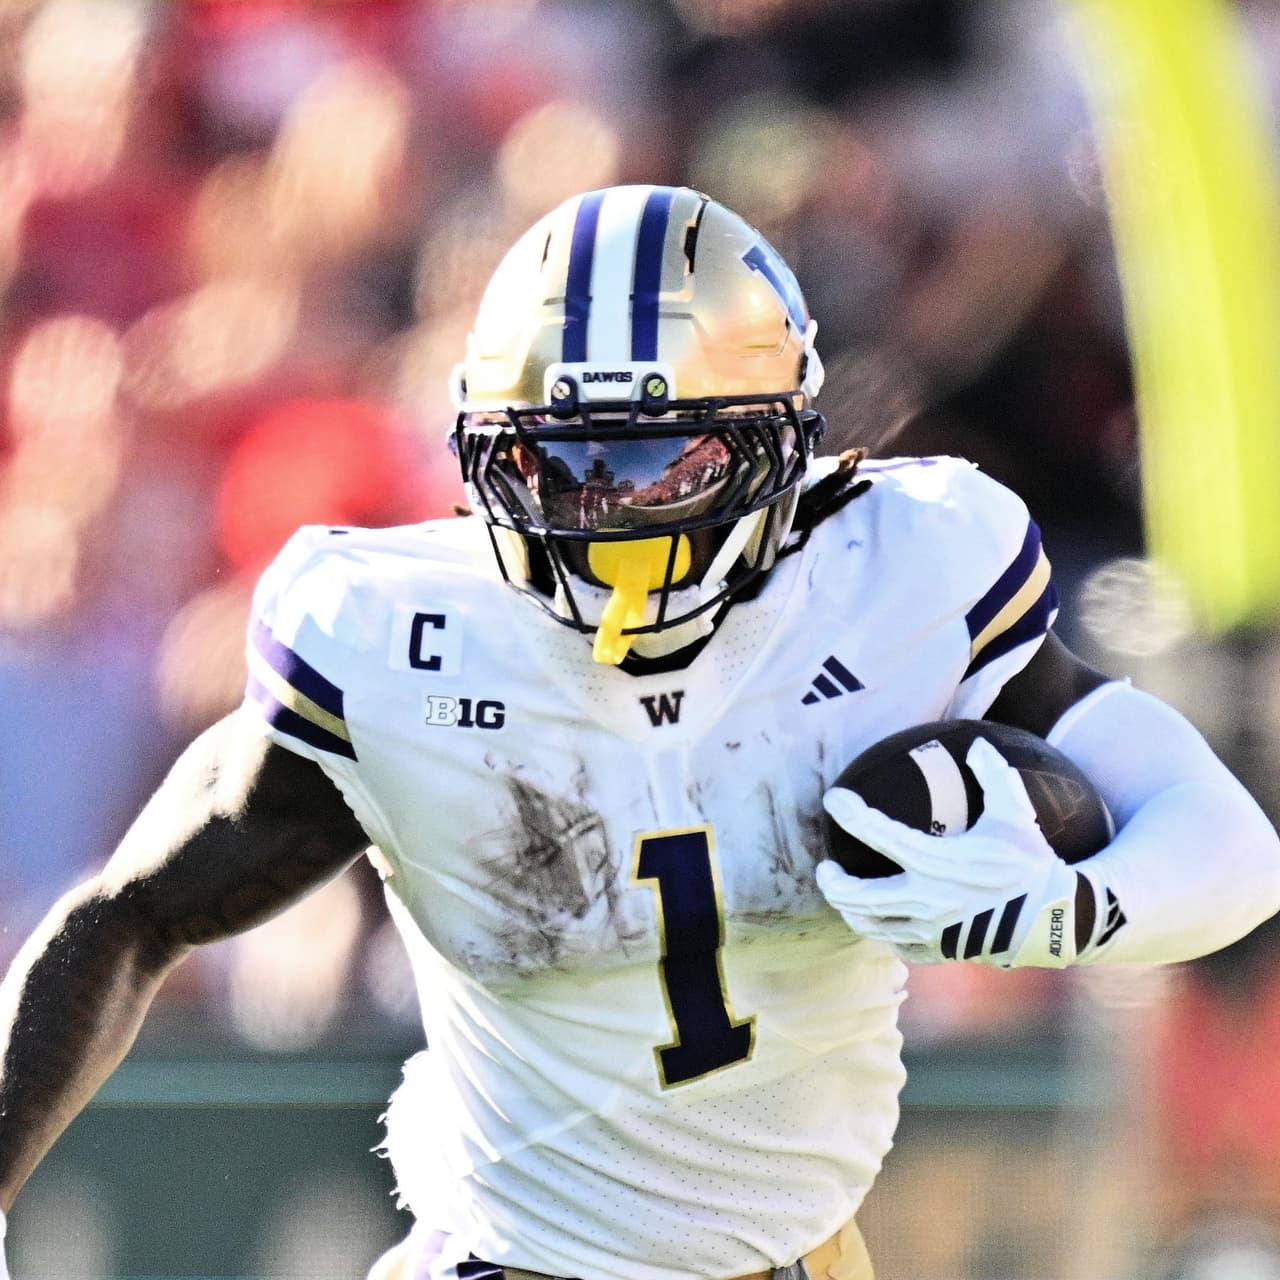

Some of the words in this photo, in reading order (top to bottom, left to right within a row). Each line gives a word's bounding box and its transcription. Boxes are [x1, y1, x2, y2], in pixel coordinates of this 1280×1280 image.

[582, 371, 633, 383] DAWGS
[409, 612, 446, 671] C
[640, 690, 685, 727] W
[629, 824, 757, 1090] 1
[1049, 908, 1064, 958] ADIZERO
